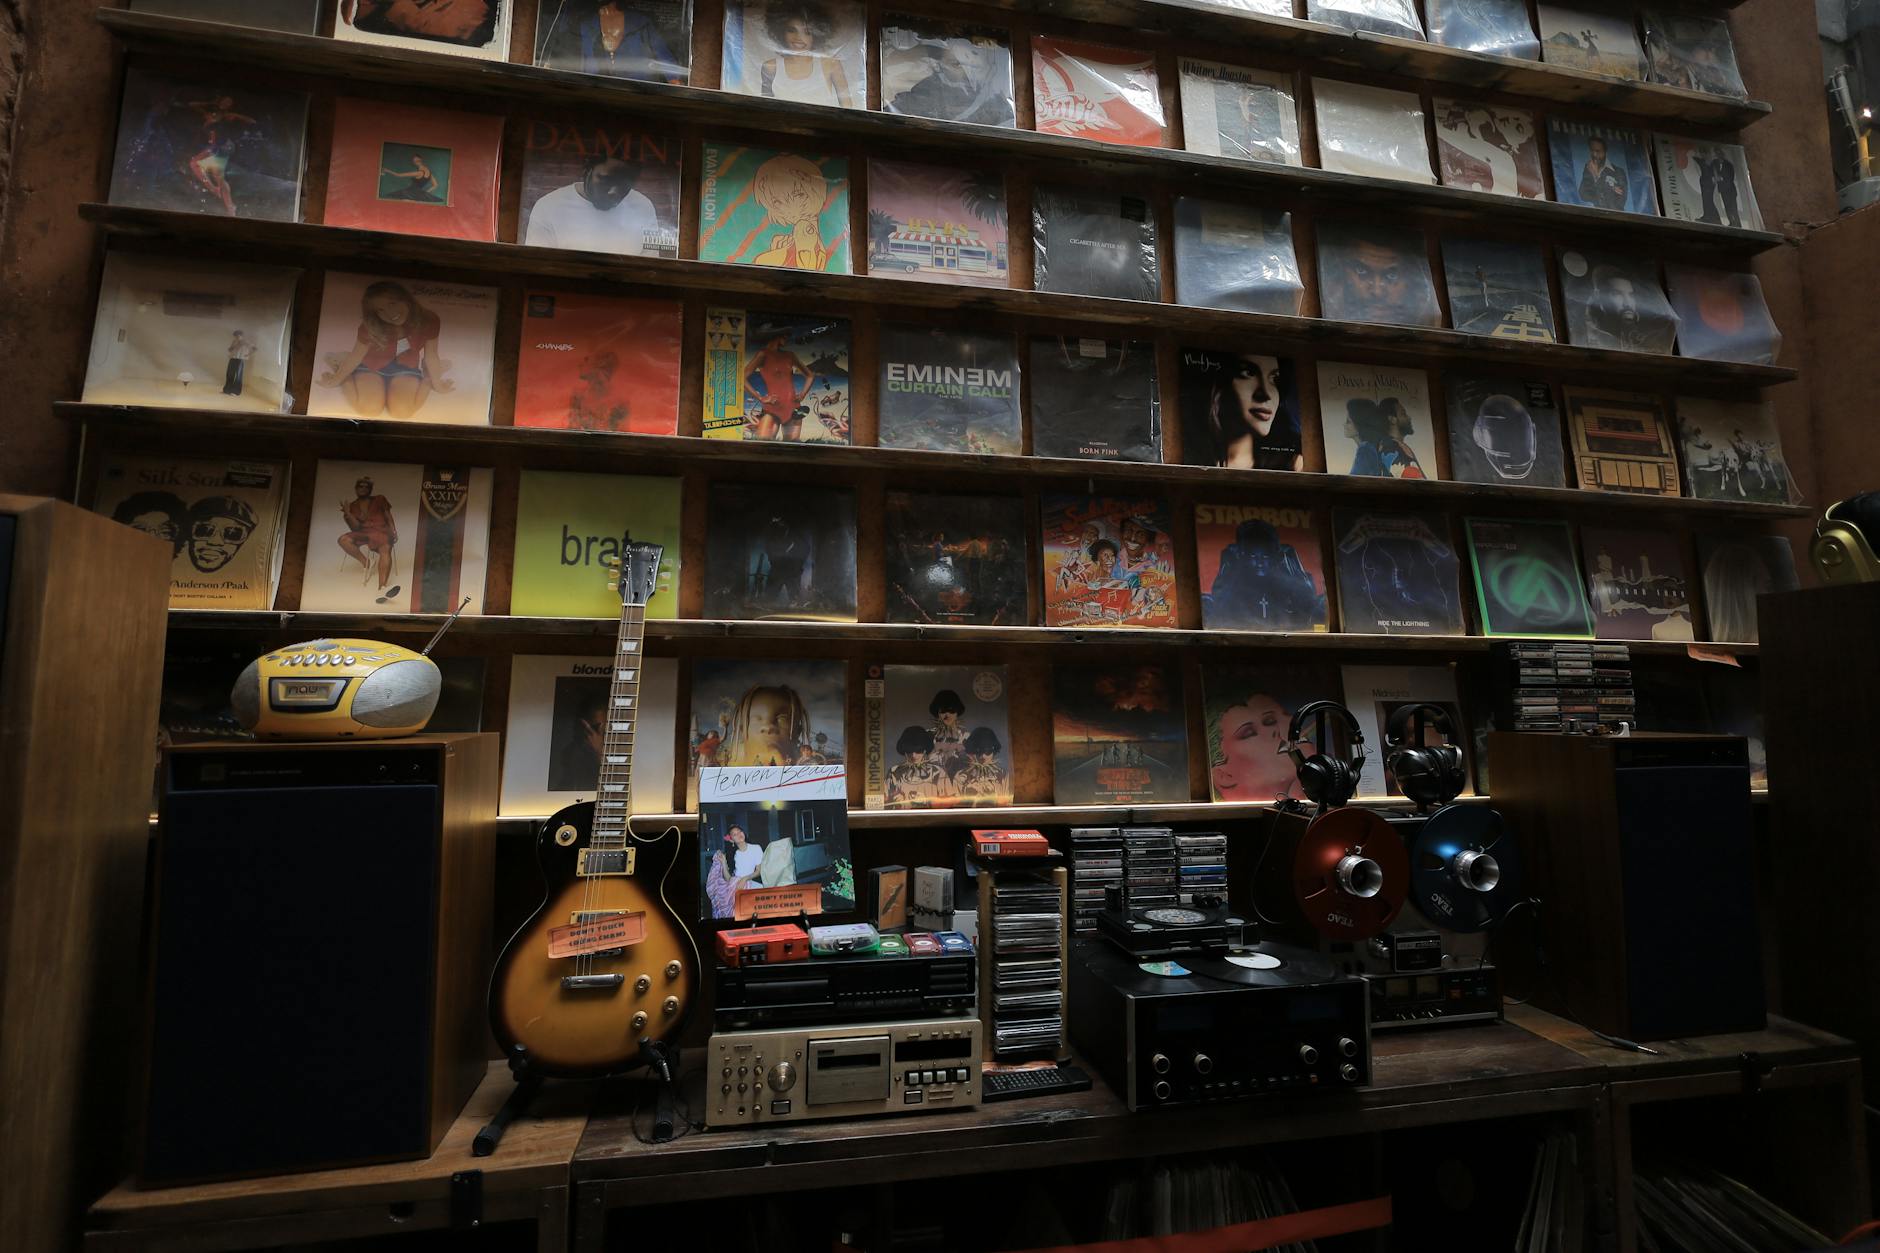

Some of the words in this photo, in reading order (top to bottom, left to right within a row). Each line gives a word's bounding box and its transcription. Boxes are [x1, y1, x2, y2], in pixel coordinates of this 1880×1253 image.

[704, 148, 718, 221] EVANGELION
[887, 380, 964, 396] CURTAIN
[967, 385, 1011, 399] CALL
[1079, 447, 1100, 455] BORN
[1101, 448, 1119, 456] PINK
[138, 464, 182, 485] Silk
[187, 469, 228, 488] Son
[1196, 503, 1313, 529] STARBOY
[170, 580, 219, 589] Anderson
[699, 766, 778, 795] Heaven
[1431, 892, 1454, 917] TEAC
[596, 921, 625, 932] TOUCH
[1327, 911, 1354, 928] TEAC
